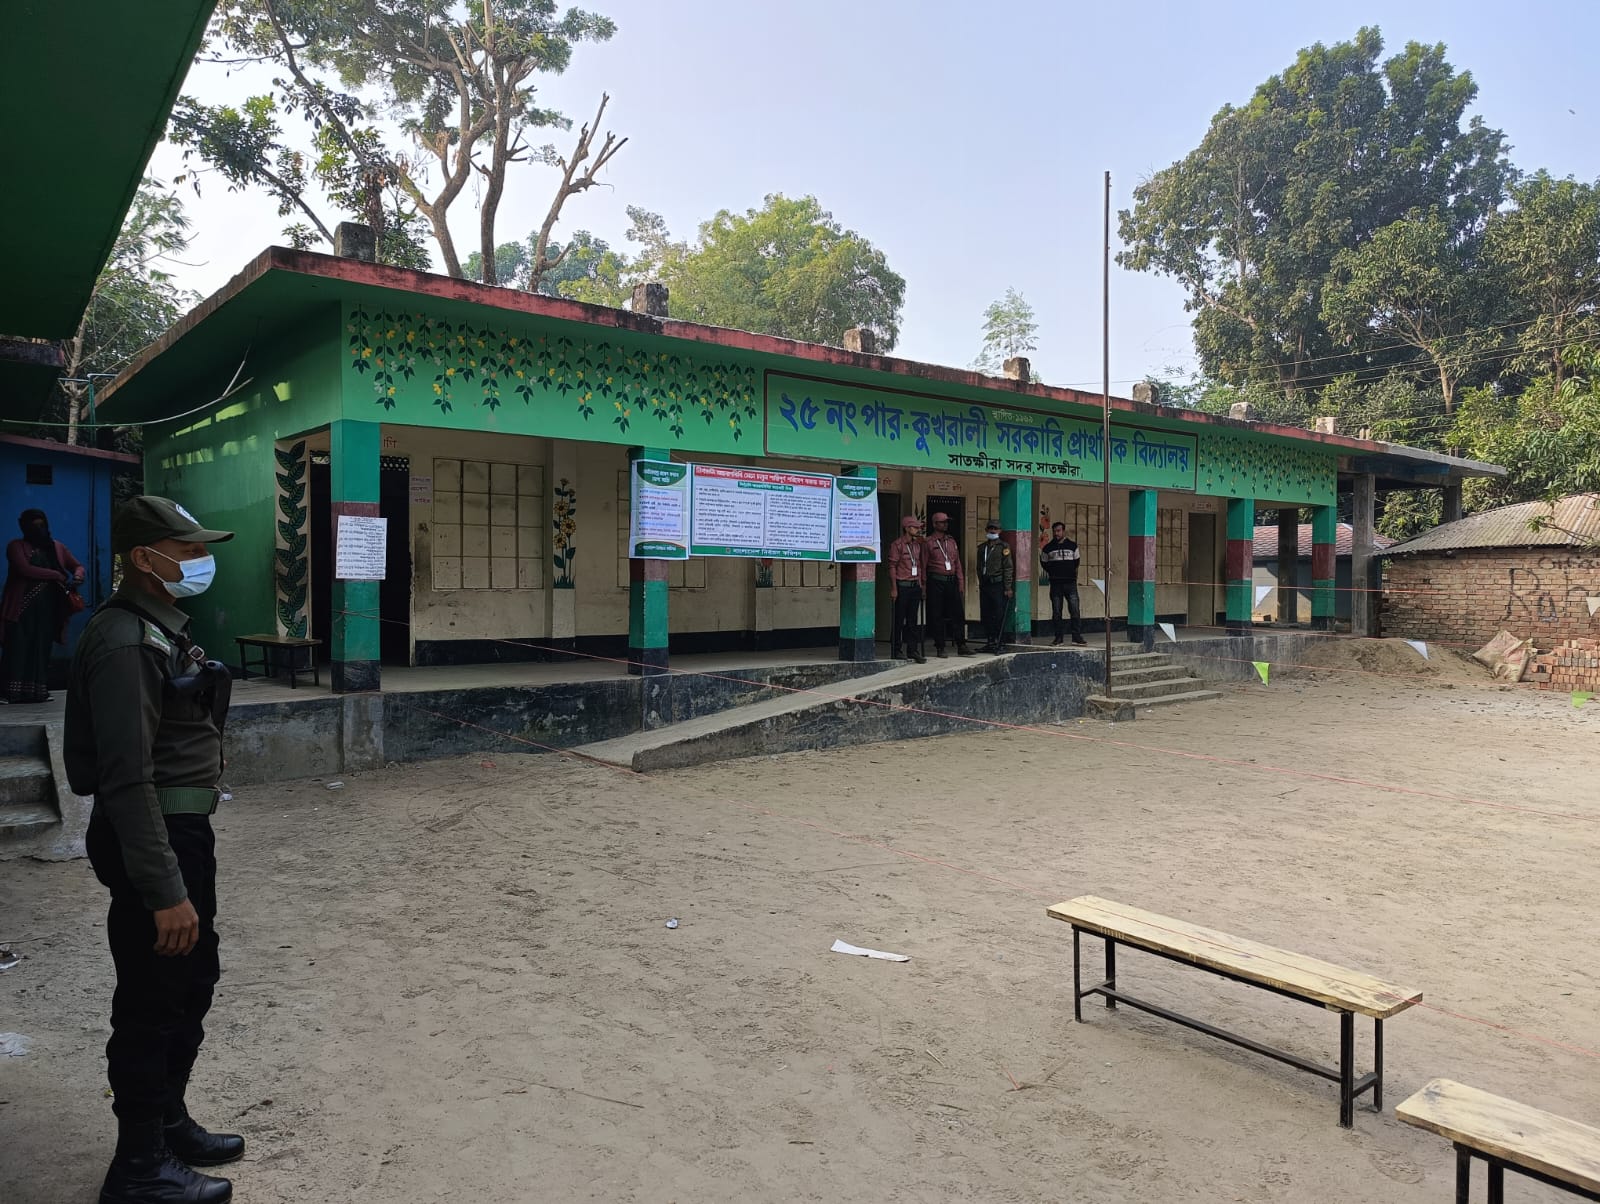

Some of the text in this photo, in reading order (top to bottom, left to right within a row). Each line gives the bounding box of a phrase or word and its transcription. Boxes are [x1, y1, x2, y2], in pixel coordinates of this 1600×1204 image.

[779, 393, 820, 432] ২৫
[824, 399, 858, 438] নং
[995, 417, 1064, 458] সরকারি
[1132, 430, 1190, 473] বিদ্যালয়
[948, 452, 1002, 471] সাতক্ষীরা
